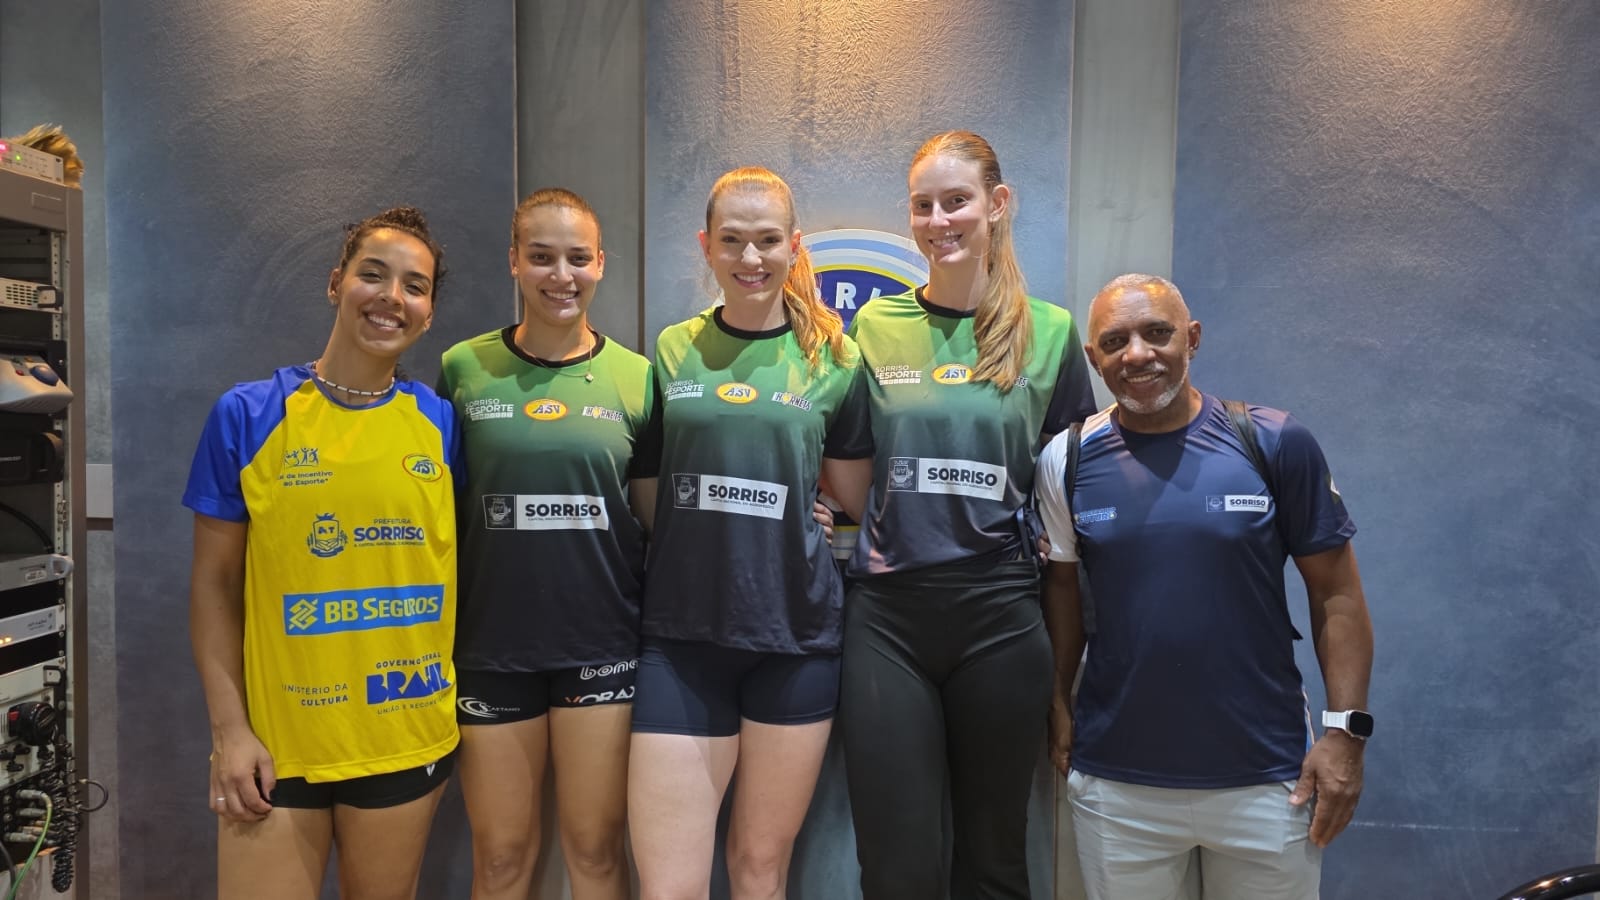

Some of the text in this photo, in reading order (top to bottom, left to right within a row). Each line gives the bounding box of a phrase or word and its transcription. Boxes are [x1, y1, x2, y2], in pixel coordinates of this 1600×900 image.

[940, 368, 967, 379] ASV
[724, 387, 751, 398] ASV
[532, 404, 560, 415] ASV
[927, 467, 998, 488] SORRISO
[708, 483, 778, 506] SORRISO
[1229, 498, 1266, 506] SORRISO
[525, 503, 602, 517] SORRISO
[353, 525, 425, 542] SORRISO
[324, 596, 439, 625] BB SEGUROS
[335, 682, 347, 692] DA
[301, 694, 348, 707] CULTURA
